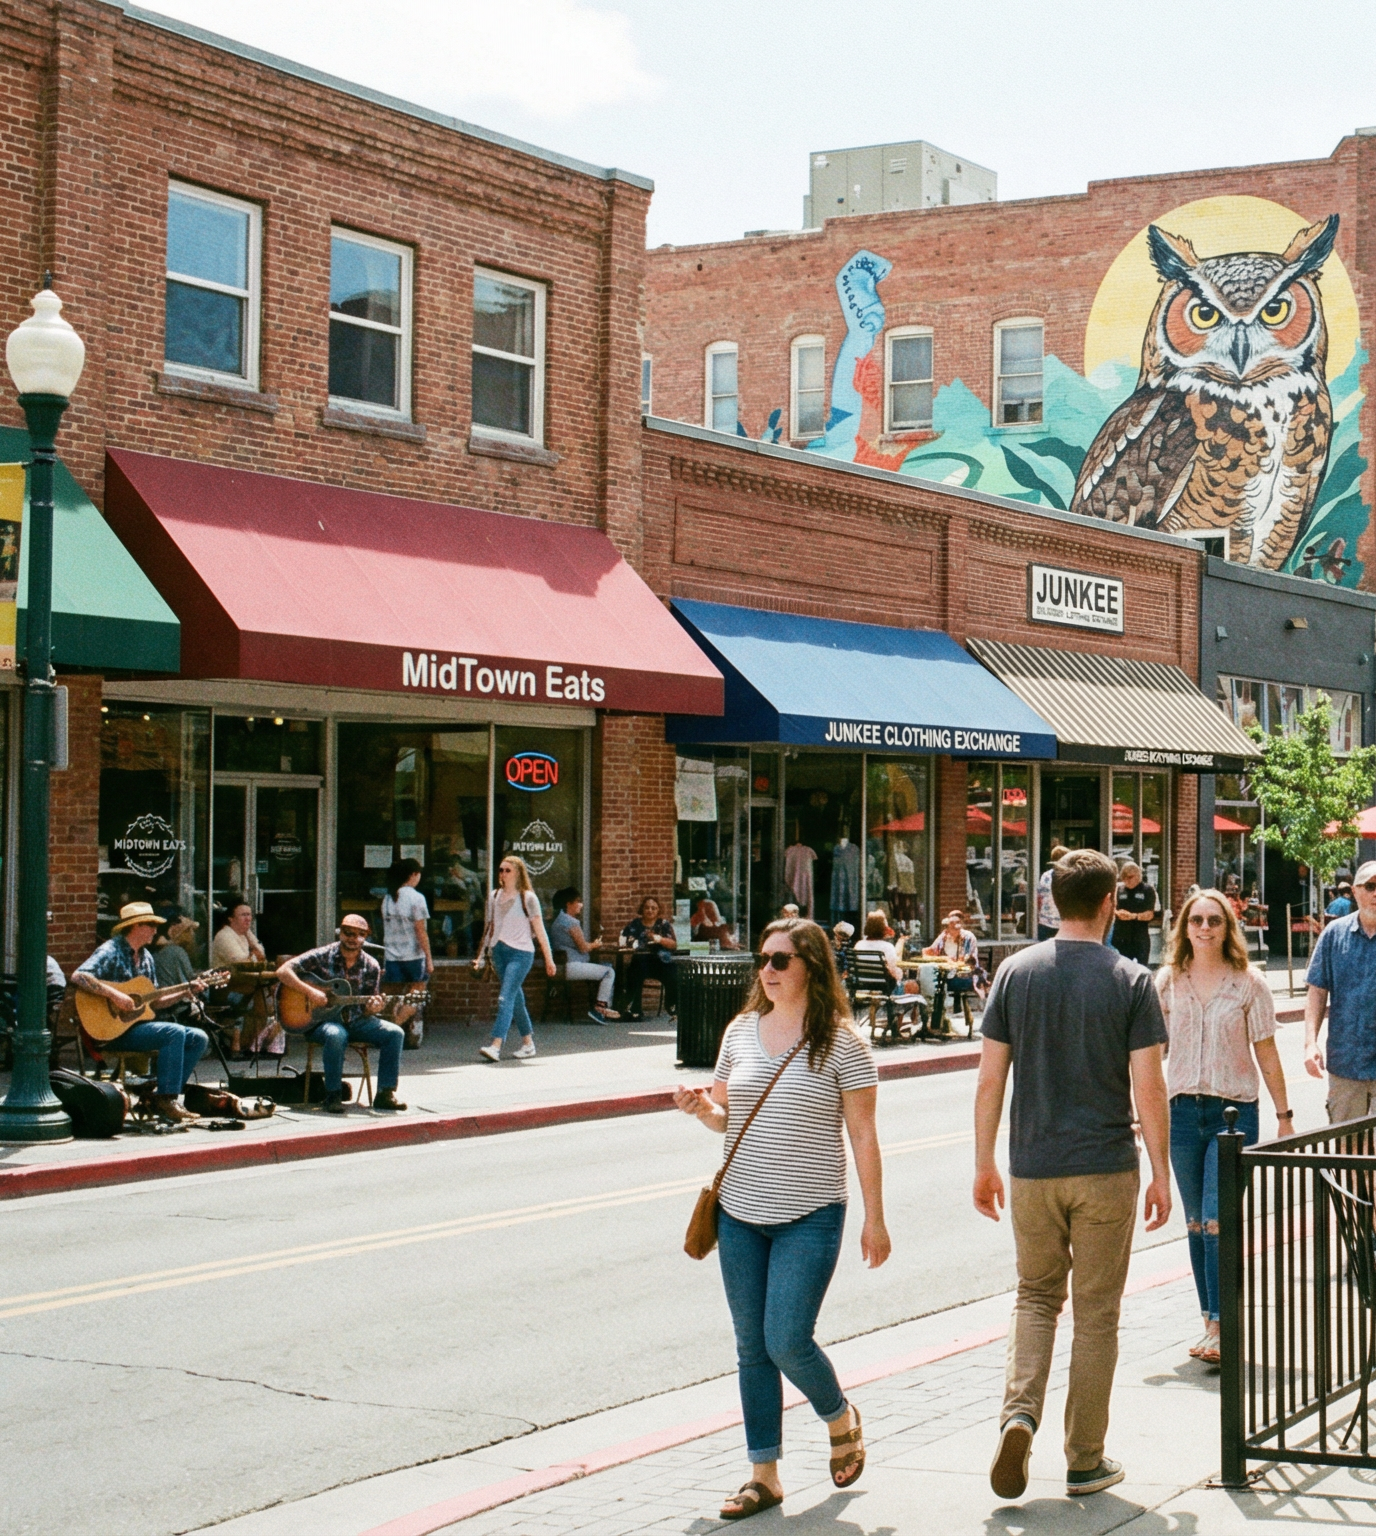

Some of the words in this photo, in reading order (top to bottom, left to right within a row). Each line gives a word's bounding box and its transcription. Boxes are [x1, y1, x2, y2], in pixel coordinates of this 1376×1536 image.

[1036, 572, 1118, 615] JUNKEE
[402, 651, 537, 697] MidTown
[545, 665, 606, 702] Eats
[825, 721, 882, 745] JUNKEE
[884, 725, 952, 749] CLOTHING
[954, 730, 1021, 753] EXCHANGE
[505, 757, 560, 785] OPEN
[114, 838, 160, 850] MIDTOWN
[162, 839, 187, 851] EATS
